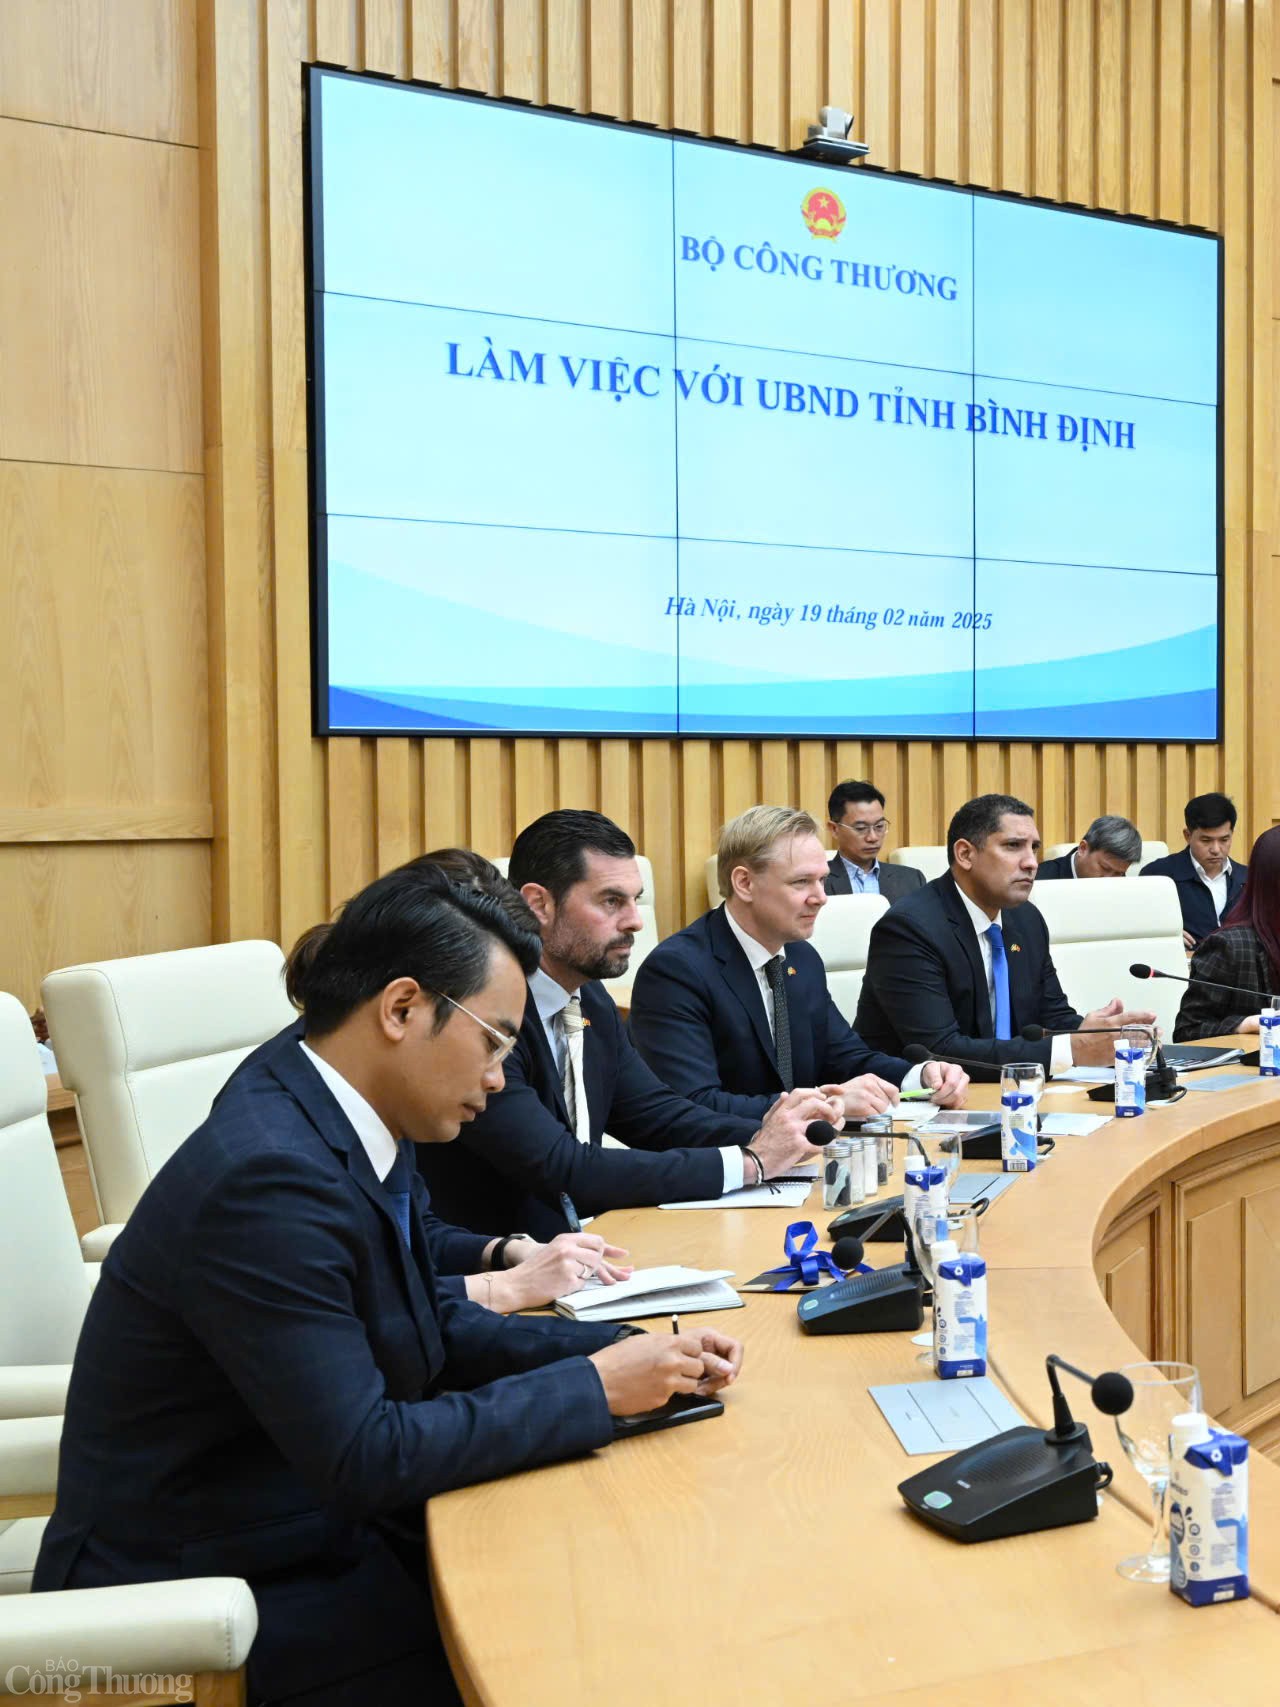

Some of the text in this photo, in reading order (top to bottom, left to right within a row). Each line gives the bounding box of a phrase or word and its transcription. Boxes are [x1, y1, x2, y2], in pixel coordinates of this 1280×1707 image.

[680, 235, 957, 301] BỘ CÔNG THƯƠNG
[445, 336, 1136, 452] LÀM VIỆC VỚI UBND TỈNH BÌNH ĐỊNH
[664, 597, 992, 630] Hà Nội, ngày 19 tháng 02 năm 2025
